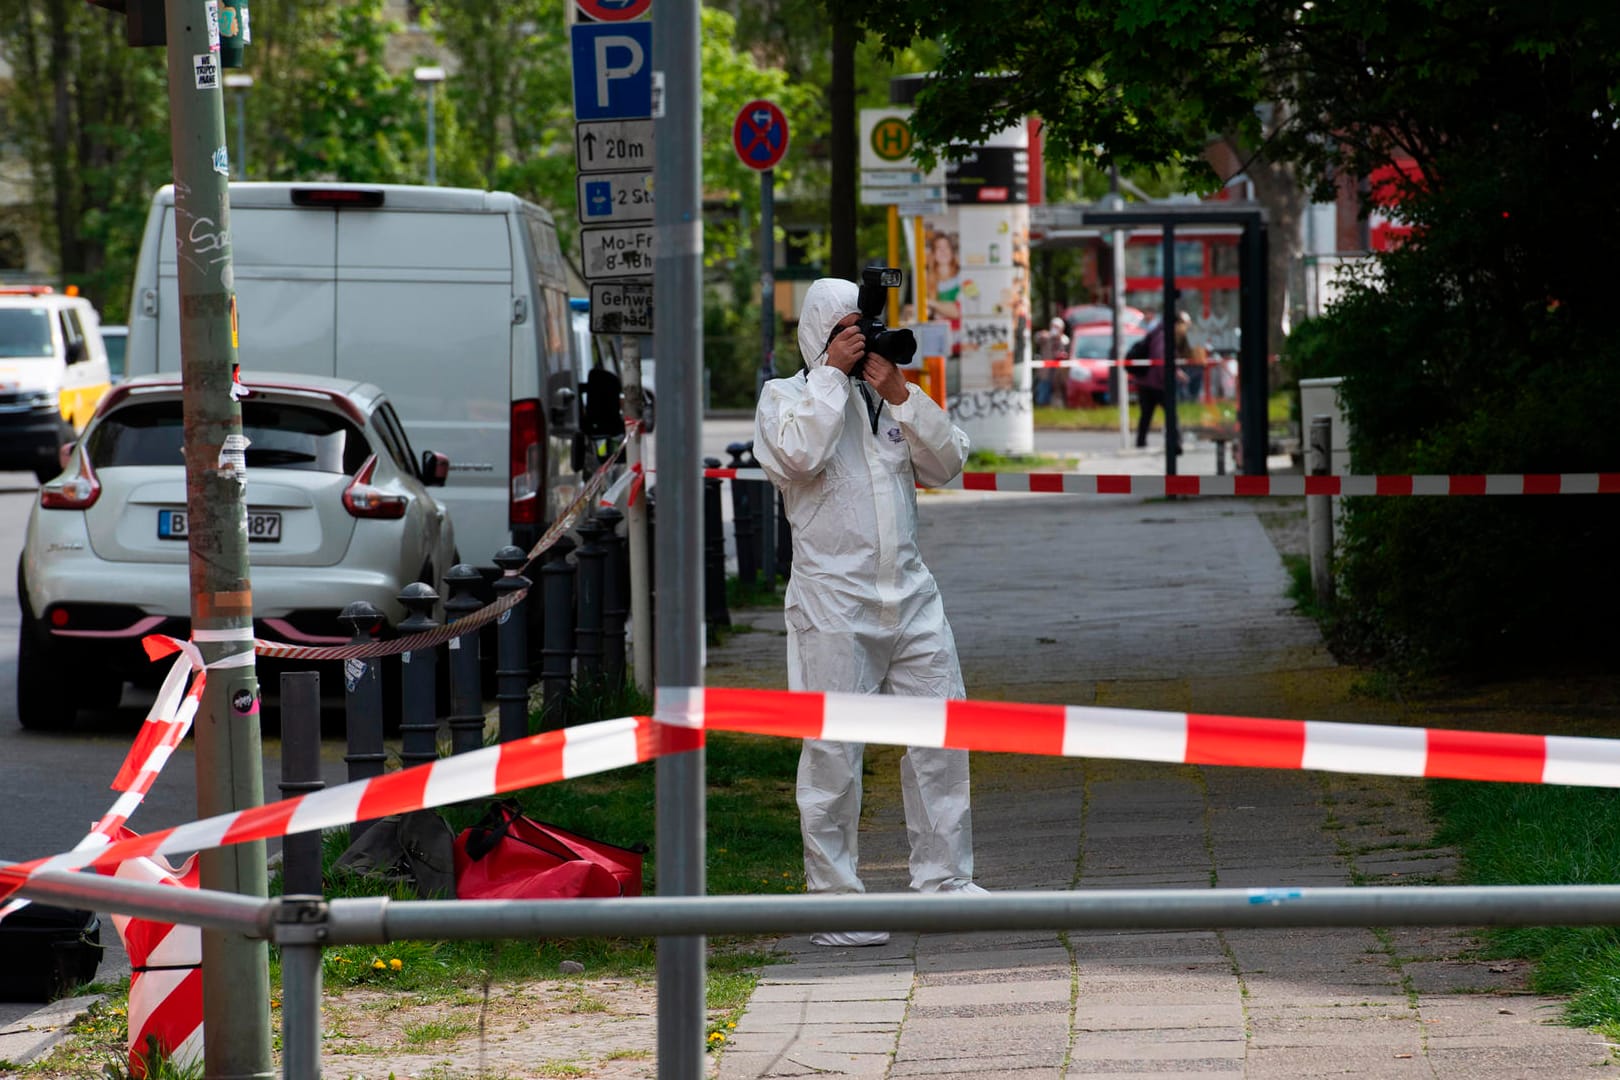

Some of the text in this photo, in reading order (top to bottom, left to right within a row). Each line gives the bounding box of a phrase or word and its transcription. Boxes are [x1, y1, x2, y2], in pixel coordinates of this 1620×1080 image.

[594, 35, 644, 107] P
[883, 128, 901, 150] H
[618, 189, 628, 205] 2
[601, 233, 652, 251] Mo-Fr
[171, 513, 185, 533] B
